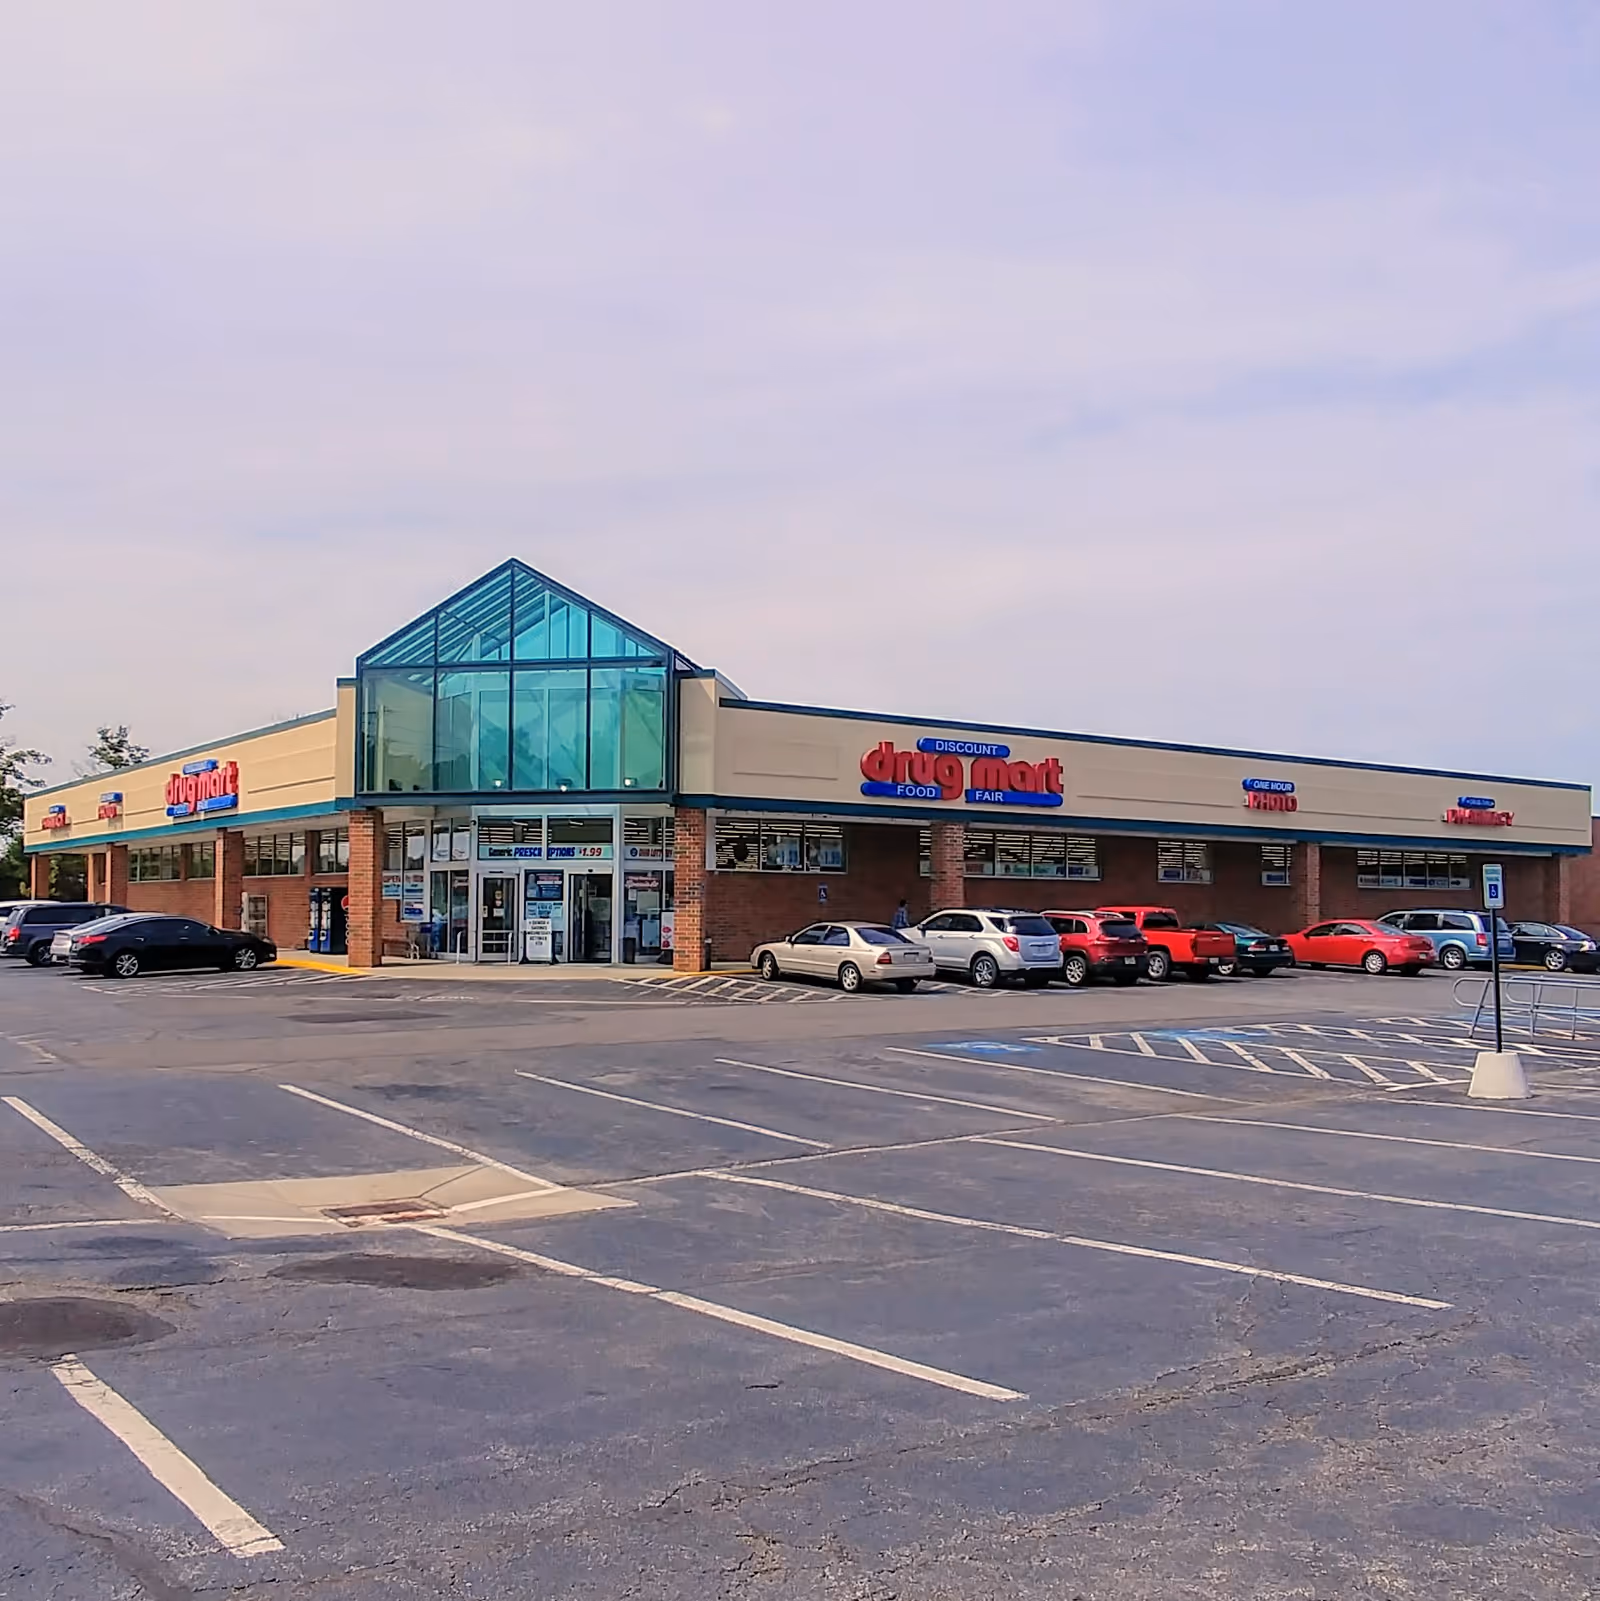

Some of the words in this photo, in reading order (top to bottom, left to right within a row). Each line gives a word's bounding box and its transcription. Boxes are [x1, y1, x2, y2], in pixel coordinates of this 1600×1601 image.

[935, 740, 998, 756] DISCOUNT
[860, 741, 964, 800] drug
[970, 757, 1064, 794] mart
[165, 773, 198, 813] drug
[196, 761, 239, 801] mart
[896, 784, 937, 798] FOOD
[974, 790, 1004, 802] FAIR
[1253, 780, 1270, 790] ONE
[1270, 782, 1293, 791] HOUR
[1247, 792, 1298, 812] PHOTO
